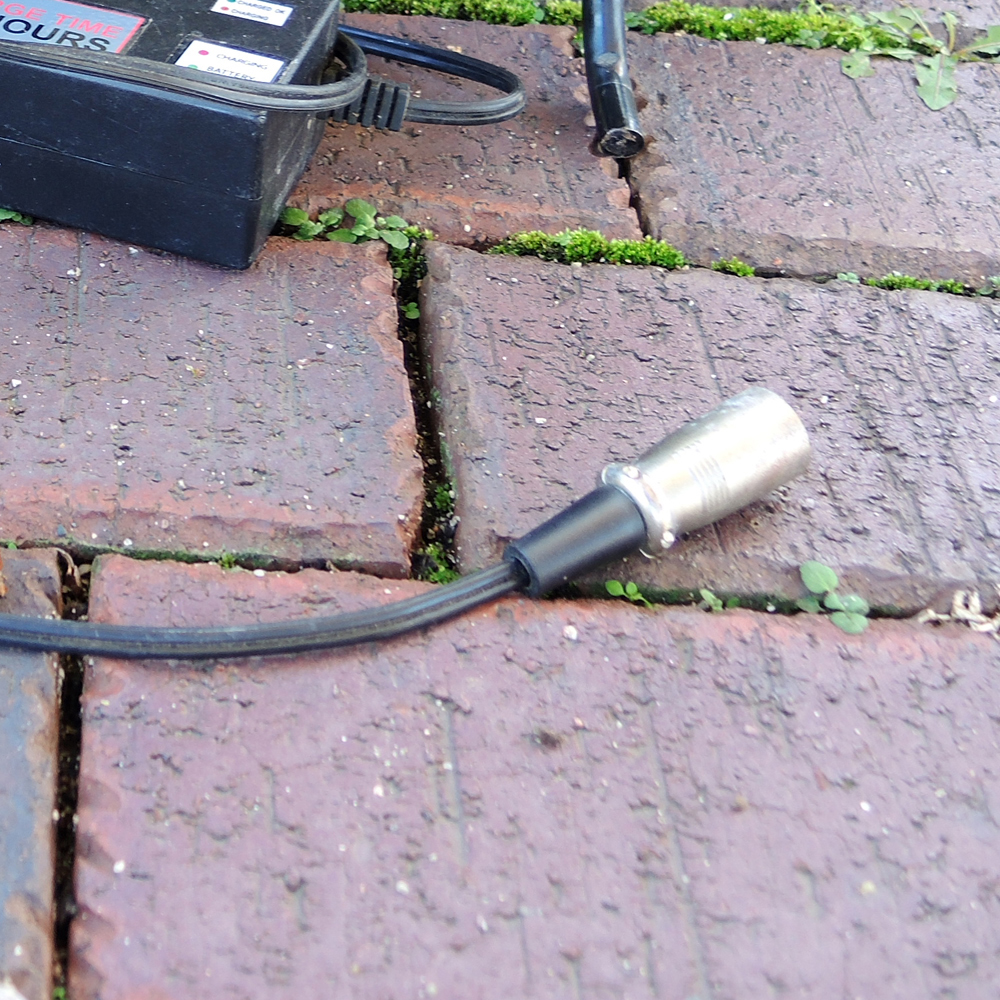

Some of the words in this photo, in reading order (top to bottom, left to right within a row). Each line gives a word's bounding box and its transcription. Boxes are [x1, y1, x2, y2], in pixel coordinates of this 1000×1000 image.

[231, 9, 269, 21] CHARGING
[56, 13, 124, 39] TIME
[216, 54, 268, 70] CHARGING
[206, 66, 256, 80] BATTERY
